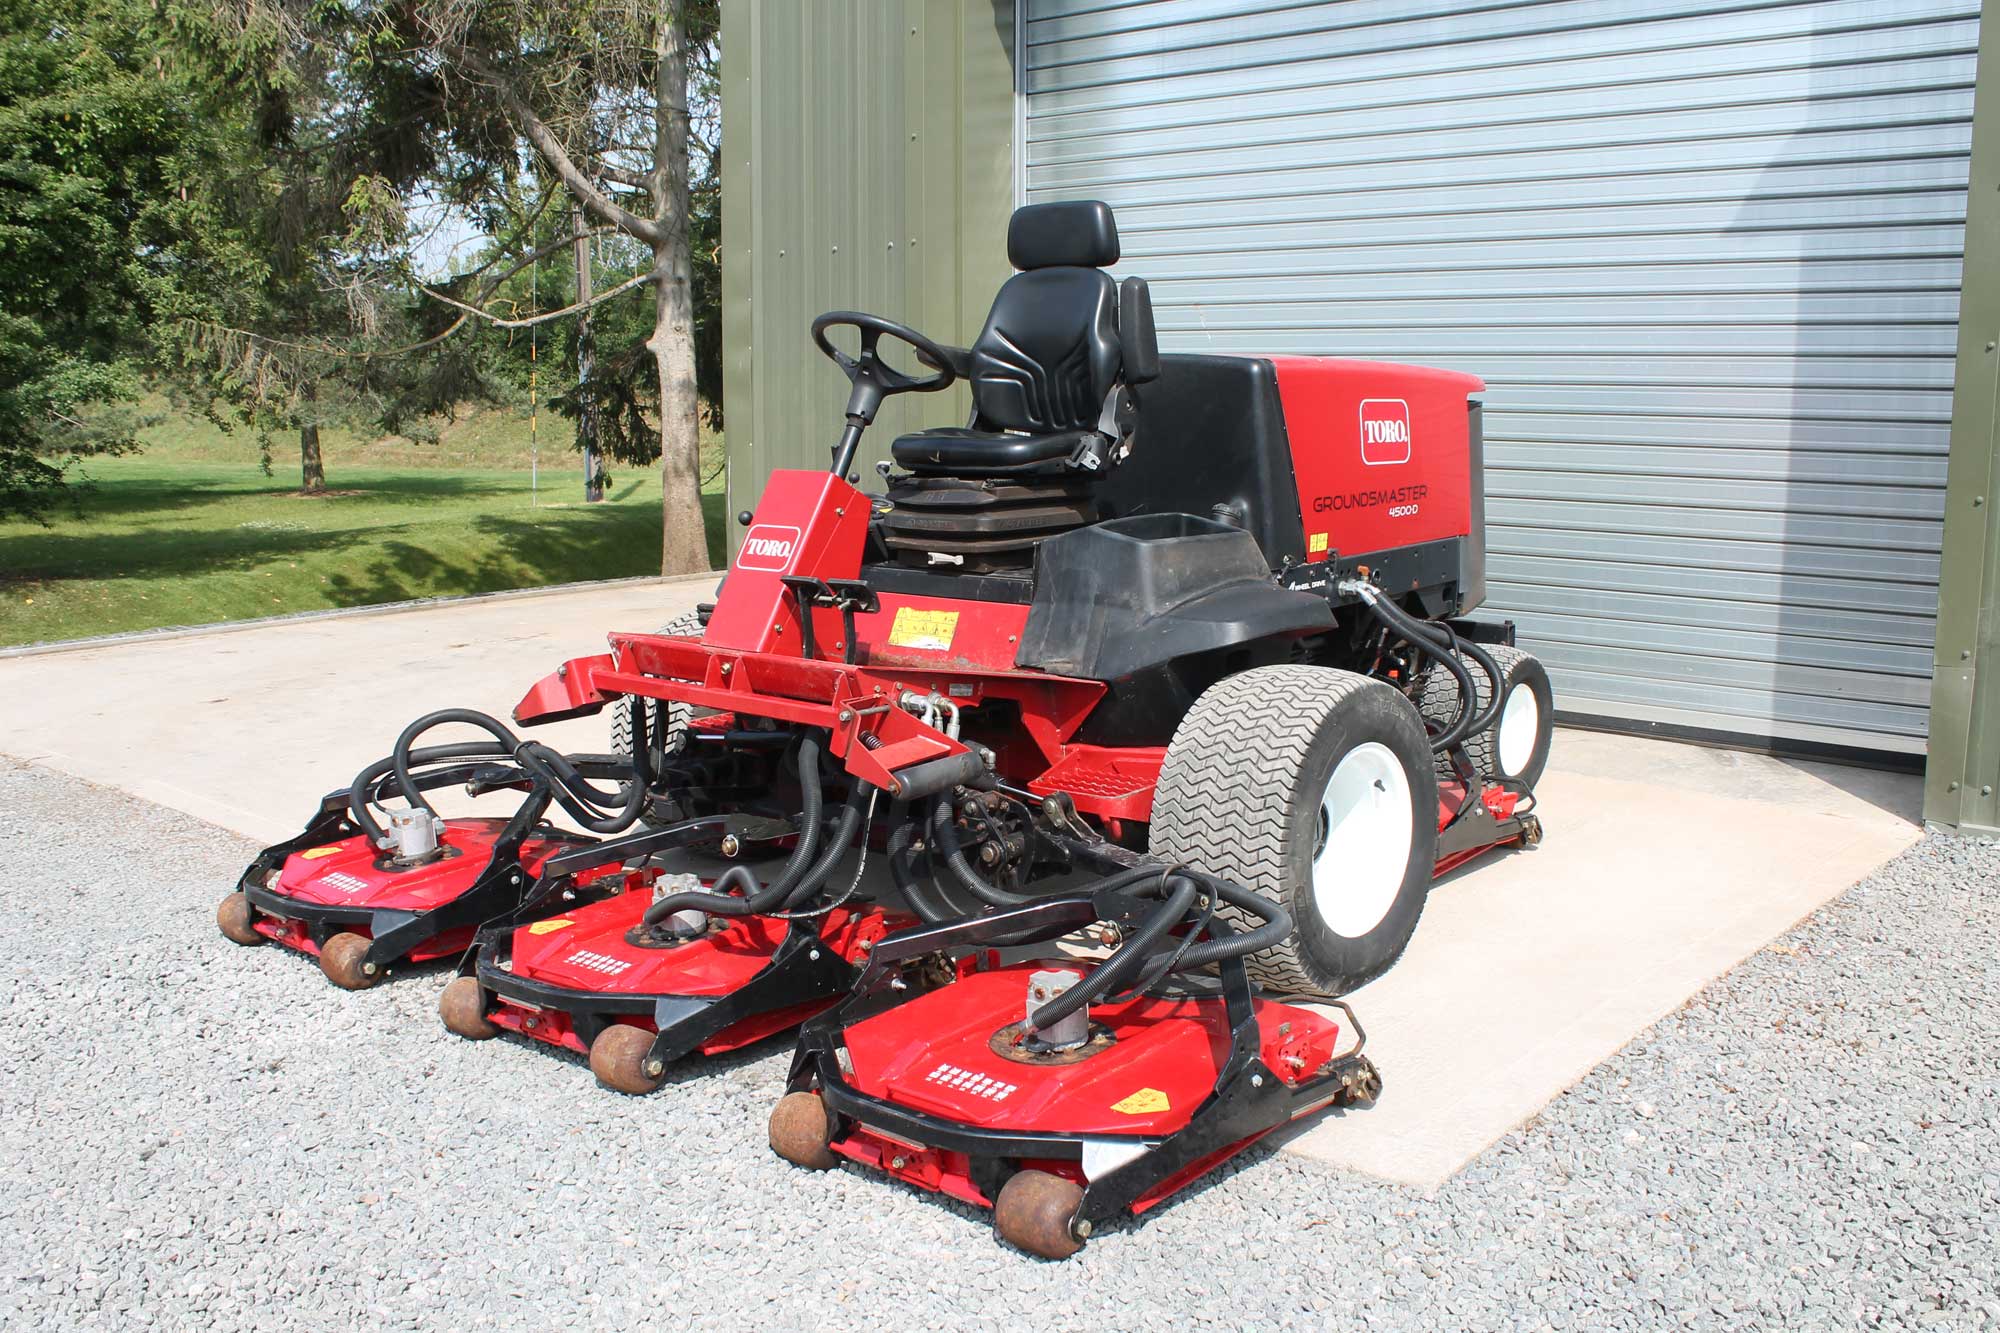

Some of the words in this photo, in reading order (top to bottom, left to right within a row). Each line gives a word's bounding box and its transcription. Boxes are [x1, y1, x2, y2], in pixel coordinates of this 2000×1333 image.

[1364, 419, 1406, 443] TORO
[1313, 485, 1428, 513] GROUNDSMASTER
[747, 538, 790, 557] TORO
